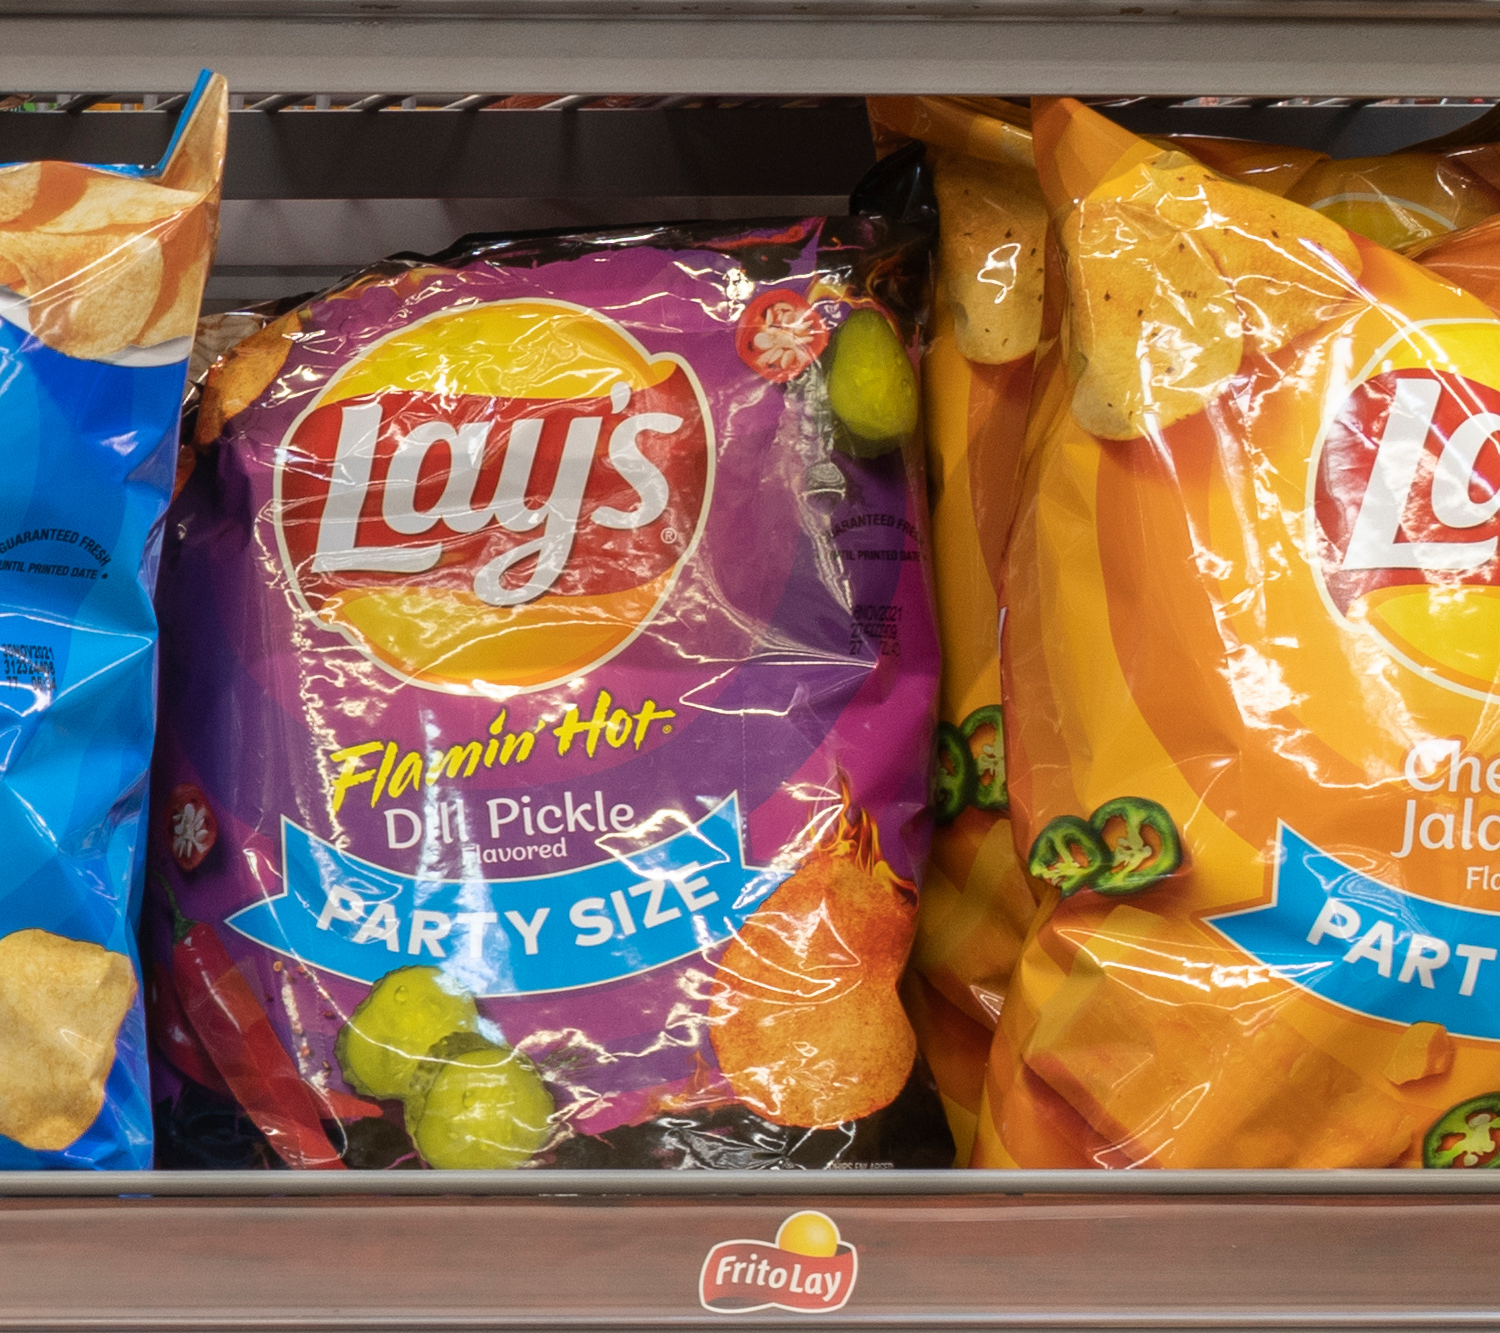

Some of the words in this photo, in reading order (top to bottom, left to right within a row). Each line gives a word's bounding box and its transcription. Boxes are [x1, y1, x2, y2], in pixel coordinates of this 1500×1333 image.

[311, 380, 685, 608] Lay's
[28, 563, 70, 578] PRINTED
[70, 565, 99, 580] DATE
[80, 535, 111, 567] FRESH
[555, 690, 676, 761] Hot
[487, 790, 636, 840] Pickle
[316, 884, 551, 960] PARTY
[570, 859, 720, 949] SIZE
[1306, 898, 1498, 998] PART
